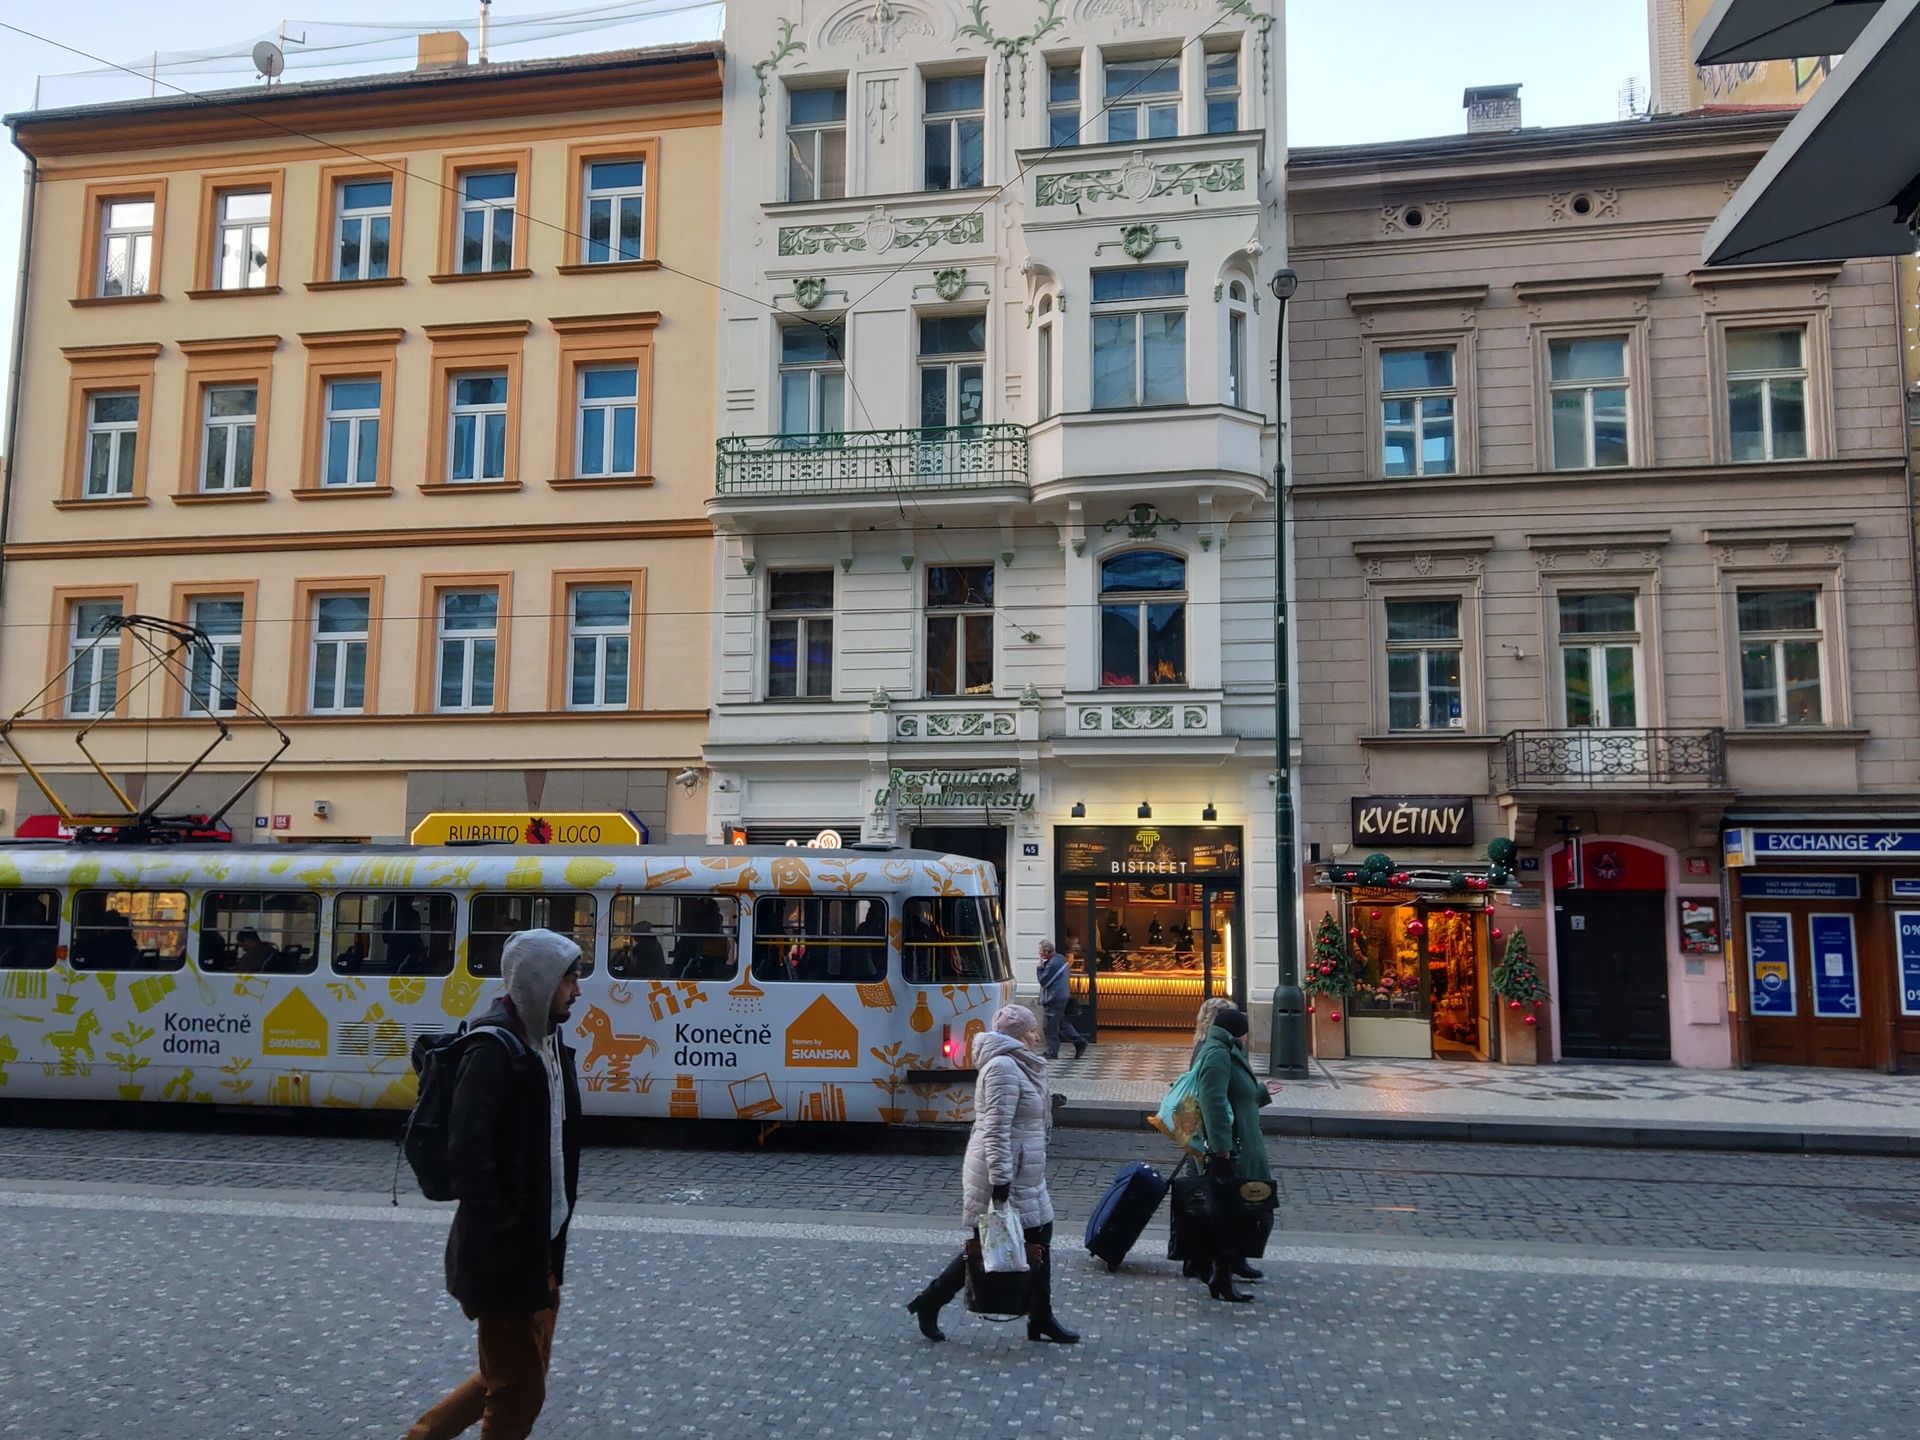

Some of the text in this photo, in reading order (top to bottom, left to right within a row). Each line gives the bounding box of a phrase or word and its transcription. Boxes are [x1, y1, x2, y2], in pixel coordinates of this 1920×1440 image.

[888, 768, 1020, 789] Restaurace
[874, 786, 1036, 812] U seminaristy
[1358, 801, 1465, 835] KVĚTINY
[558, 825, 601, 844] LOCO
[1768, 834, 1869, 850] EXCHANGE
[1025, 845, 1036, 854] 45
[1111, 861, 1187, 874] BISTREET
[1524, 860, 1536, 868] 47
[164, 1012, 251, 1034] Konečně
[675, 1023, 772, 1045] Konečně
[792, 1038, 823, 1047] Homes by
[163, 1034, 221, 1054] doma
[268, 1038, 321, 1050] SKANSKA
[674, 1046, 738, 1067] doma
[791, 1048, 851, 1061] SKANSKA
